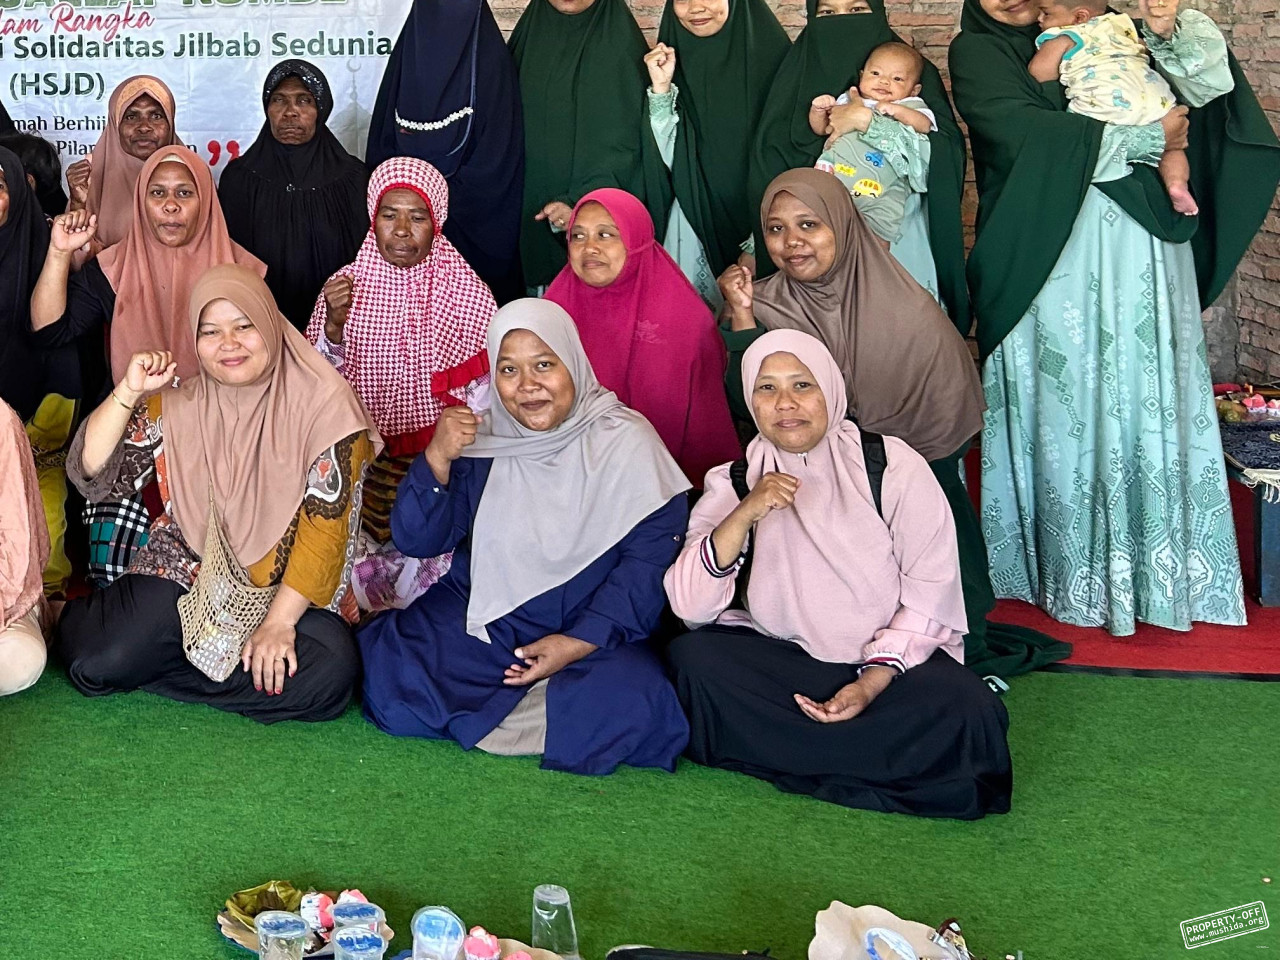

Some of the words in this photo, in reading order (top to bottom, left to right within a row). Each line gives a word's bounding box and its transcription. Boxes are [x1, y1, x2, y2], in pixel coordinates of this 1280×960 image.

[49, 0, 156, 42] Rangka
[14, 32, 165, 59] Solidaritas
[173, 31, 261, 57] Jilbab
[271, 29, 392, 57] Sedunia
[9, 72, 105, 101] (HSJD)
